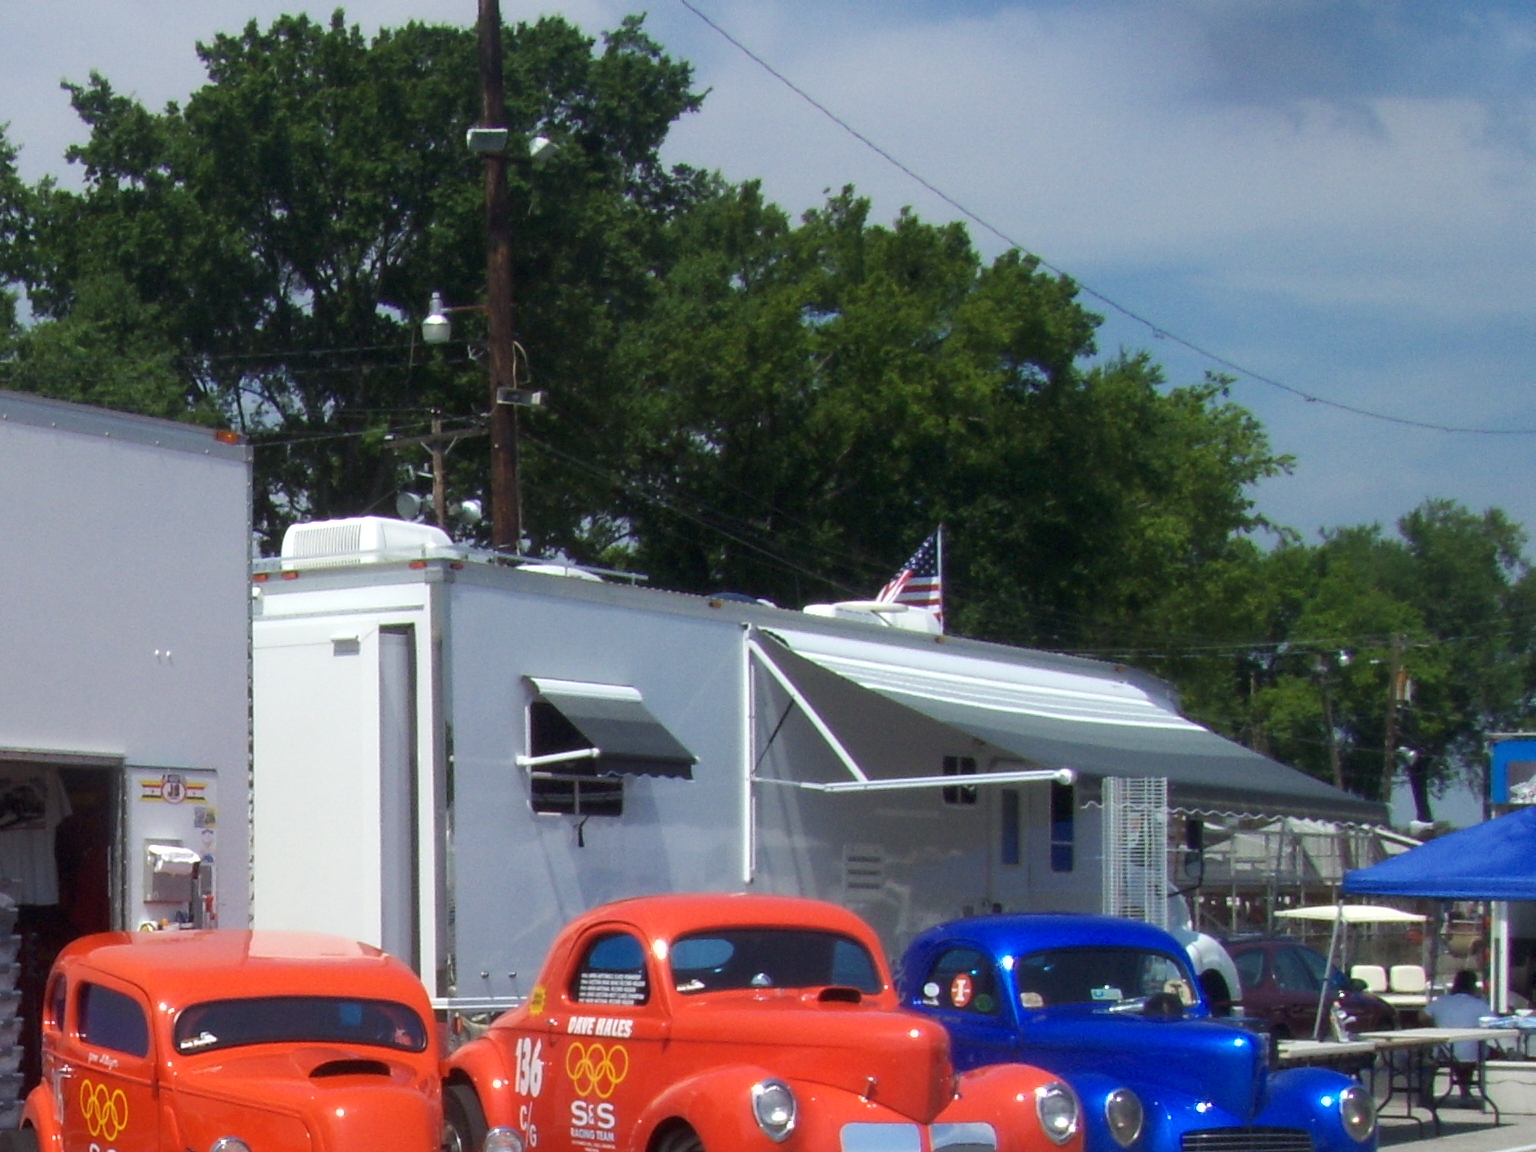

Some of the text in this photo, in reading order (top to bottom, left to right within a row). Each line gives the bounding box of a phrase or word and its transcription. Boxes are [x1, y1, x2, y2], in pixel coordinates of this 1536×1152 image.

[567, 1016, 633, 1039] DAVE HALES
[514, 1037, 543, 1098] 136
